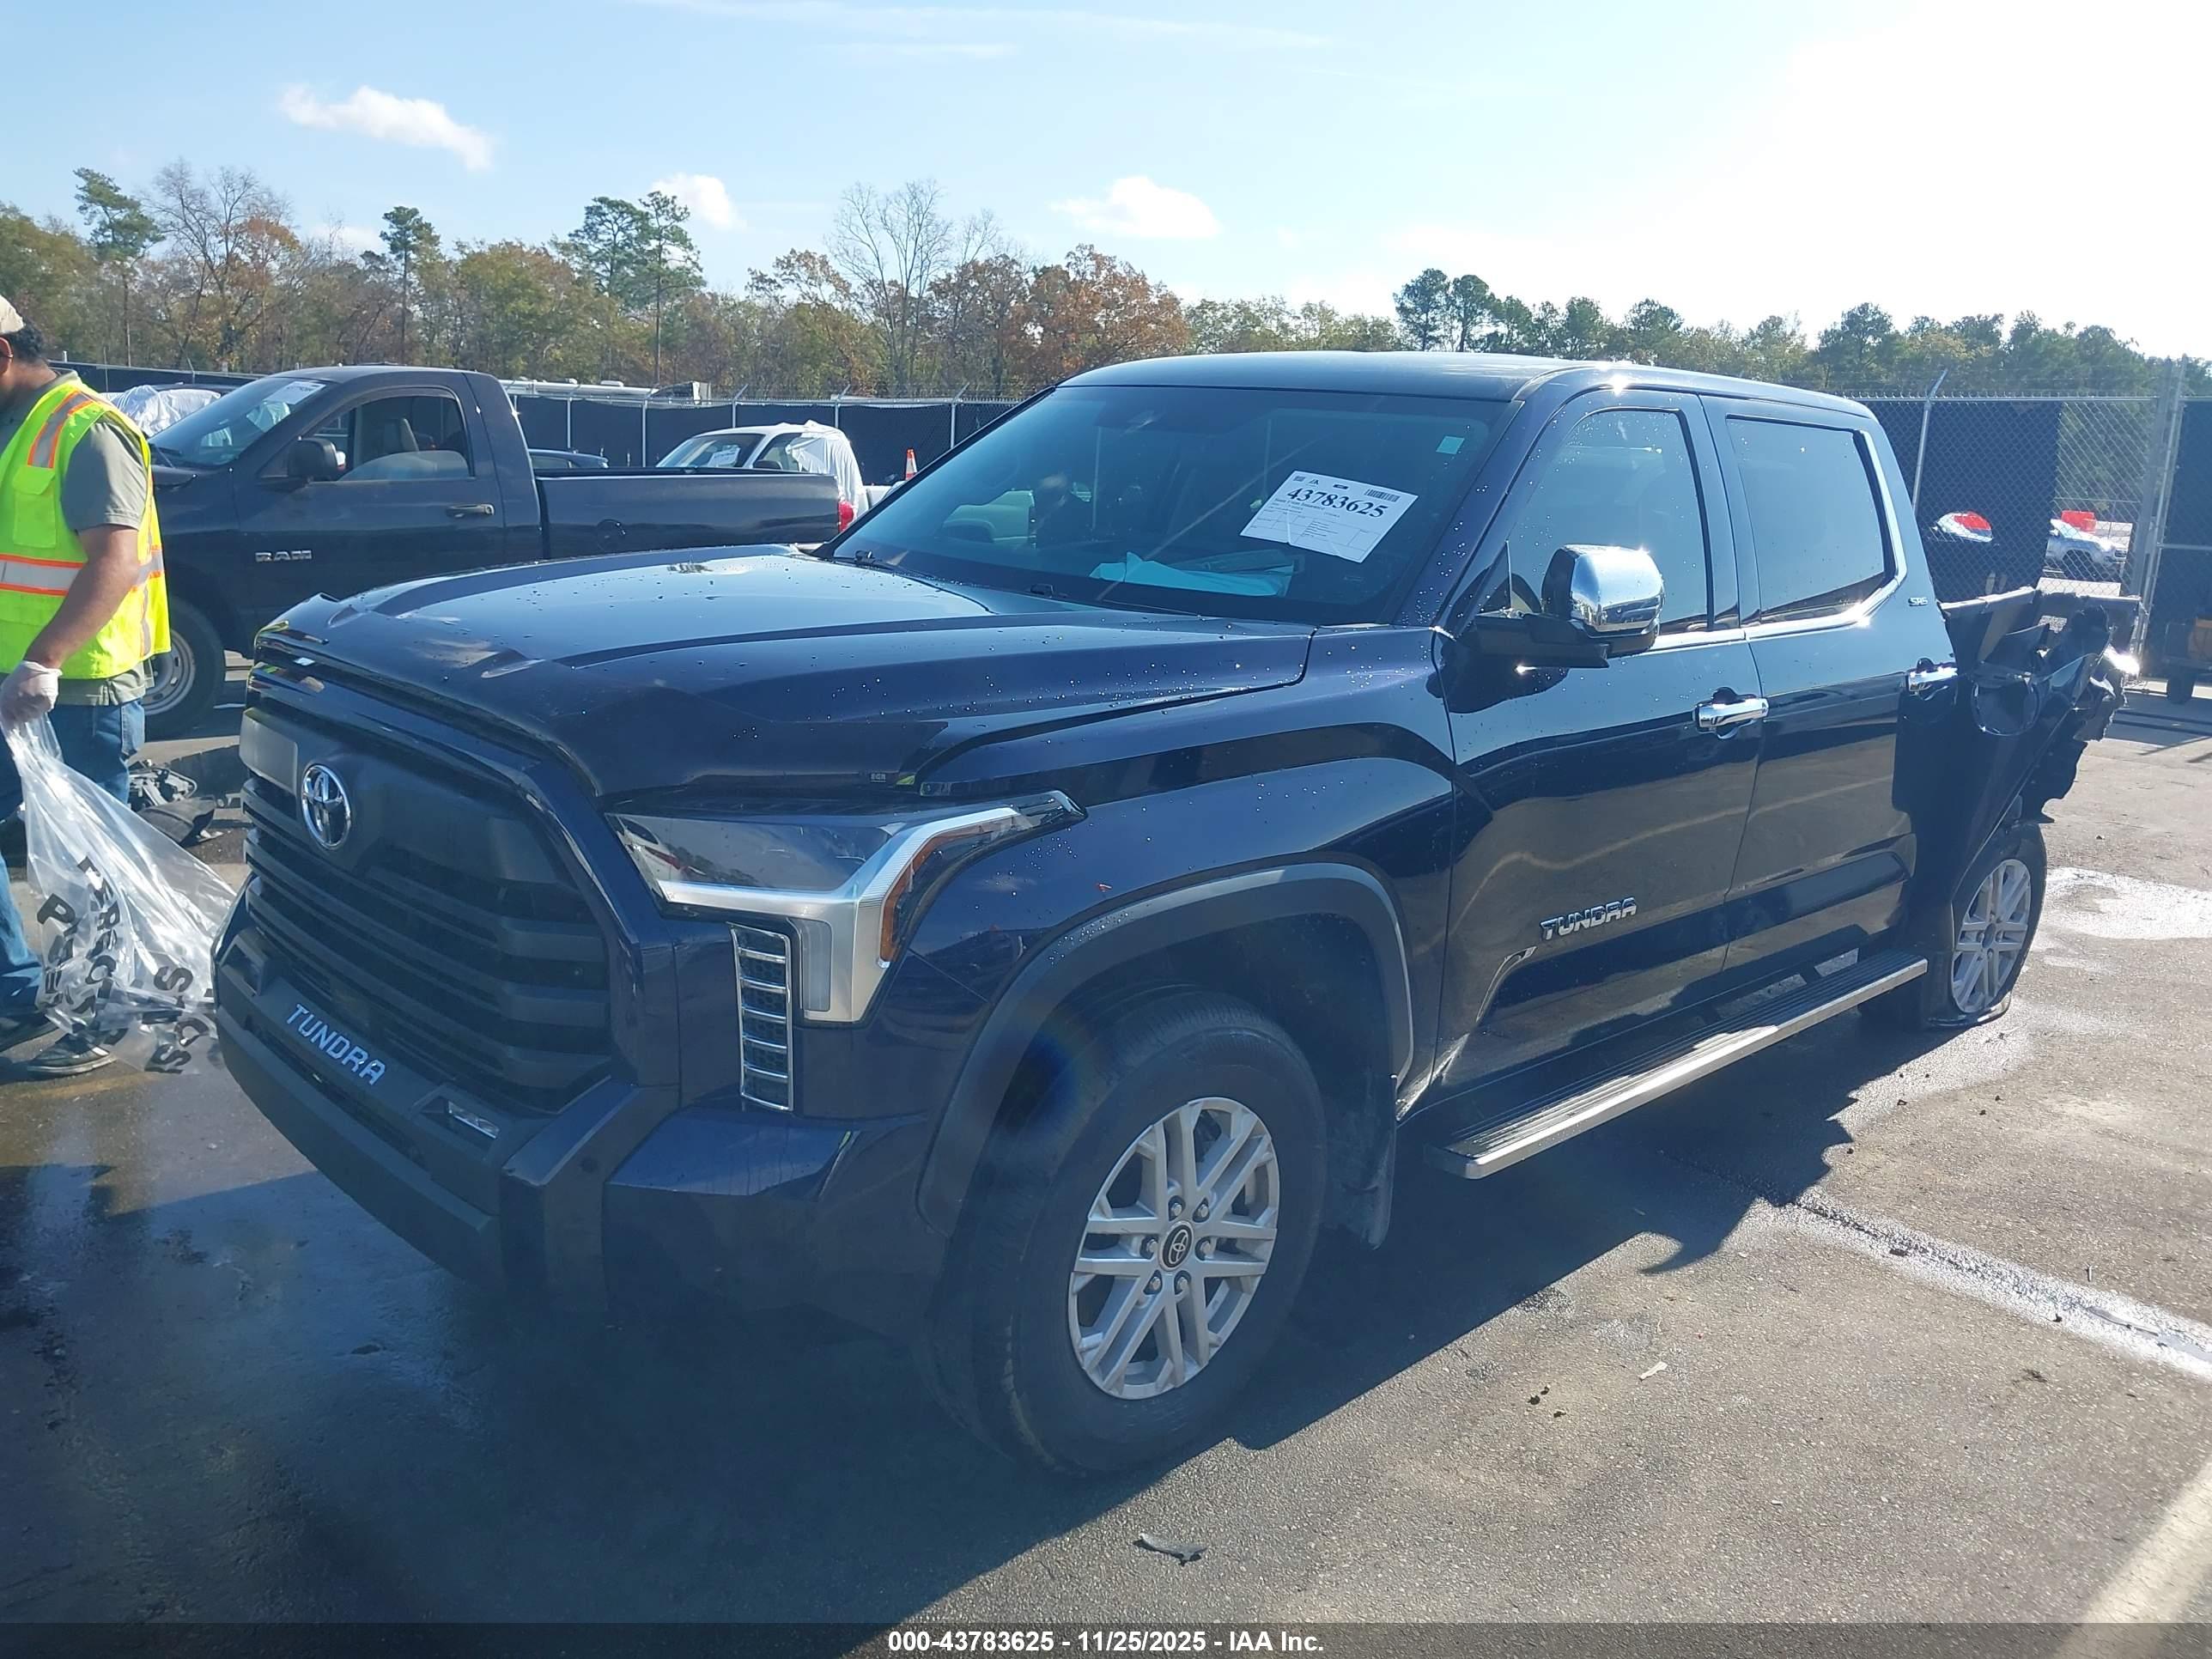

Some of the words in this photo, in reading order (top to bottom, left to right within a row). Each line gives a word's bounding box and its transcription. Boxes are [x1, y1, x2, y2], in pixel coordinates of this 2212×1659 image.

[1287, 488, 1389, 518] 43783625
[255, 550, 312, 562] RAM
[1540, 897, 1637, 940] TUNDRA
[286, 1003, 386, 1085] TUNDRA
